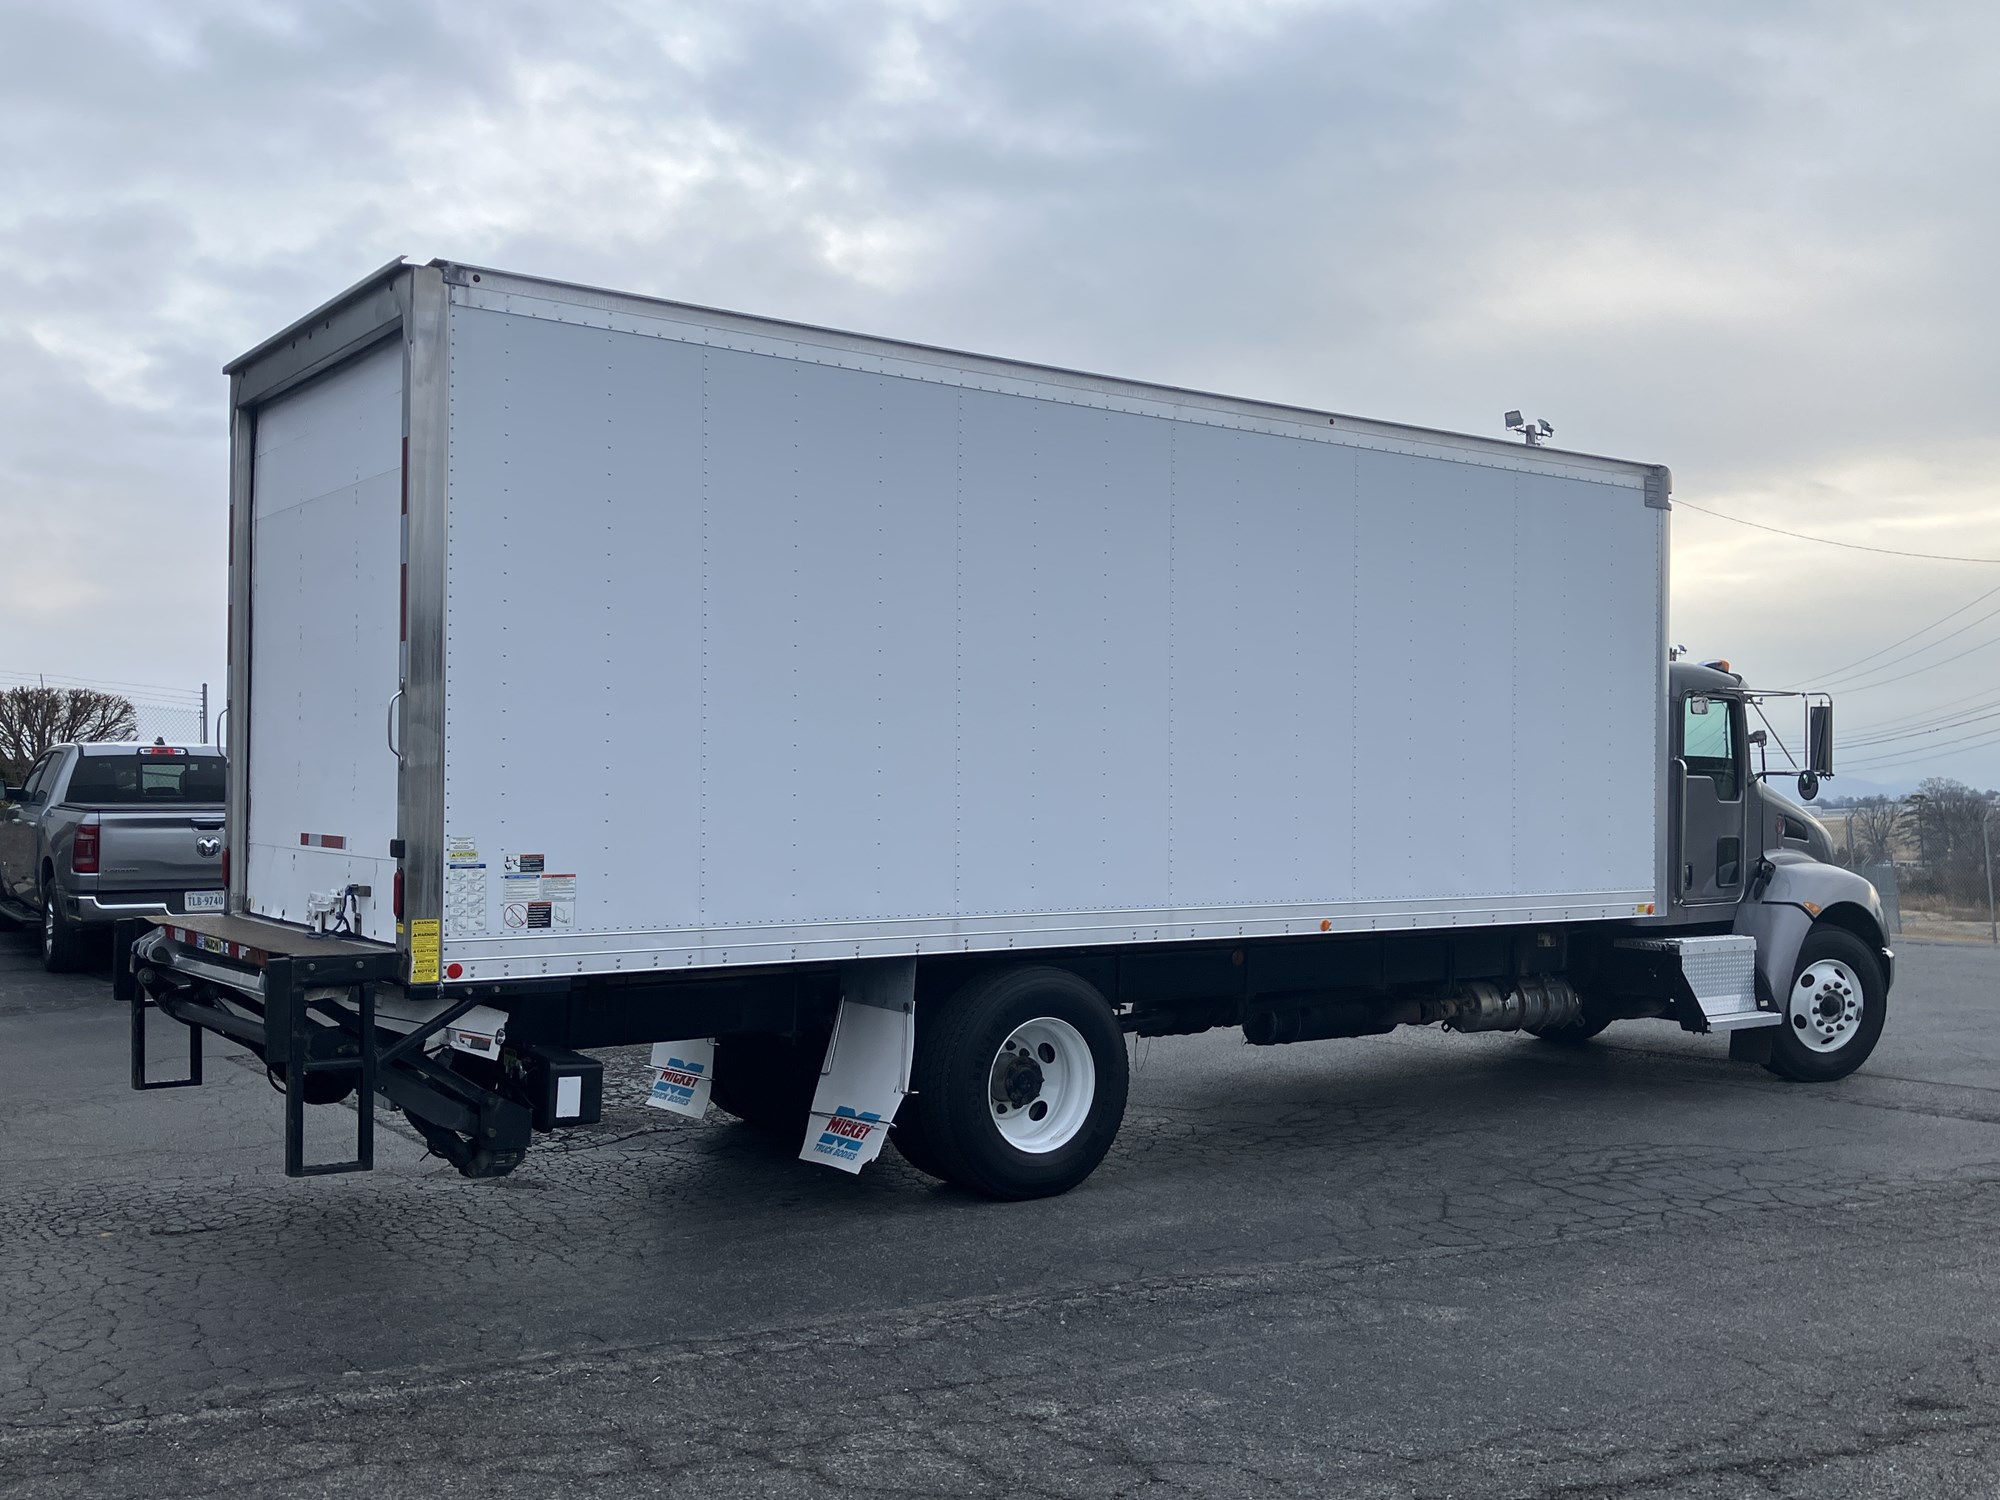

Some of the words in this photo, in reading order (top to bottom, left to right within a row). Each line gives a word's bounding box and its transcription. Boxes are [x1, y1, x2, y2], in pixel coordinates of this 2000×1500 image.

[188, 896, 223, 906] TLB-9740
[660, 1069, 699, 1088] MICKEY
[825, 1117, 873, 1140] MICKEY
[814, 1143, 834, 1156] TRUCK
[832, 1148, 858, 1160] BODIES
